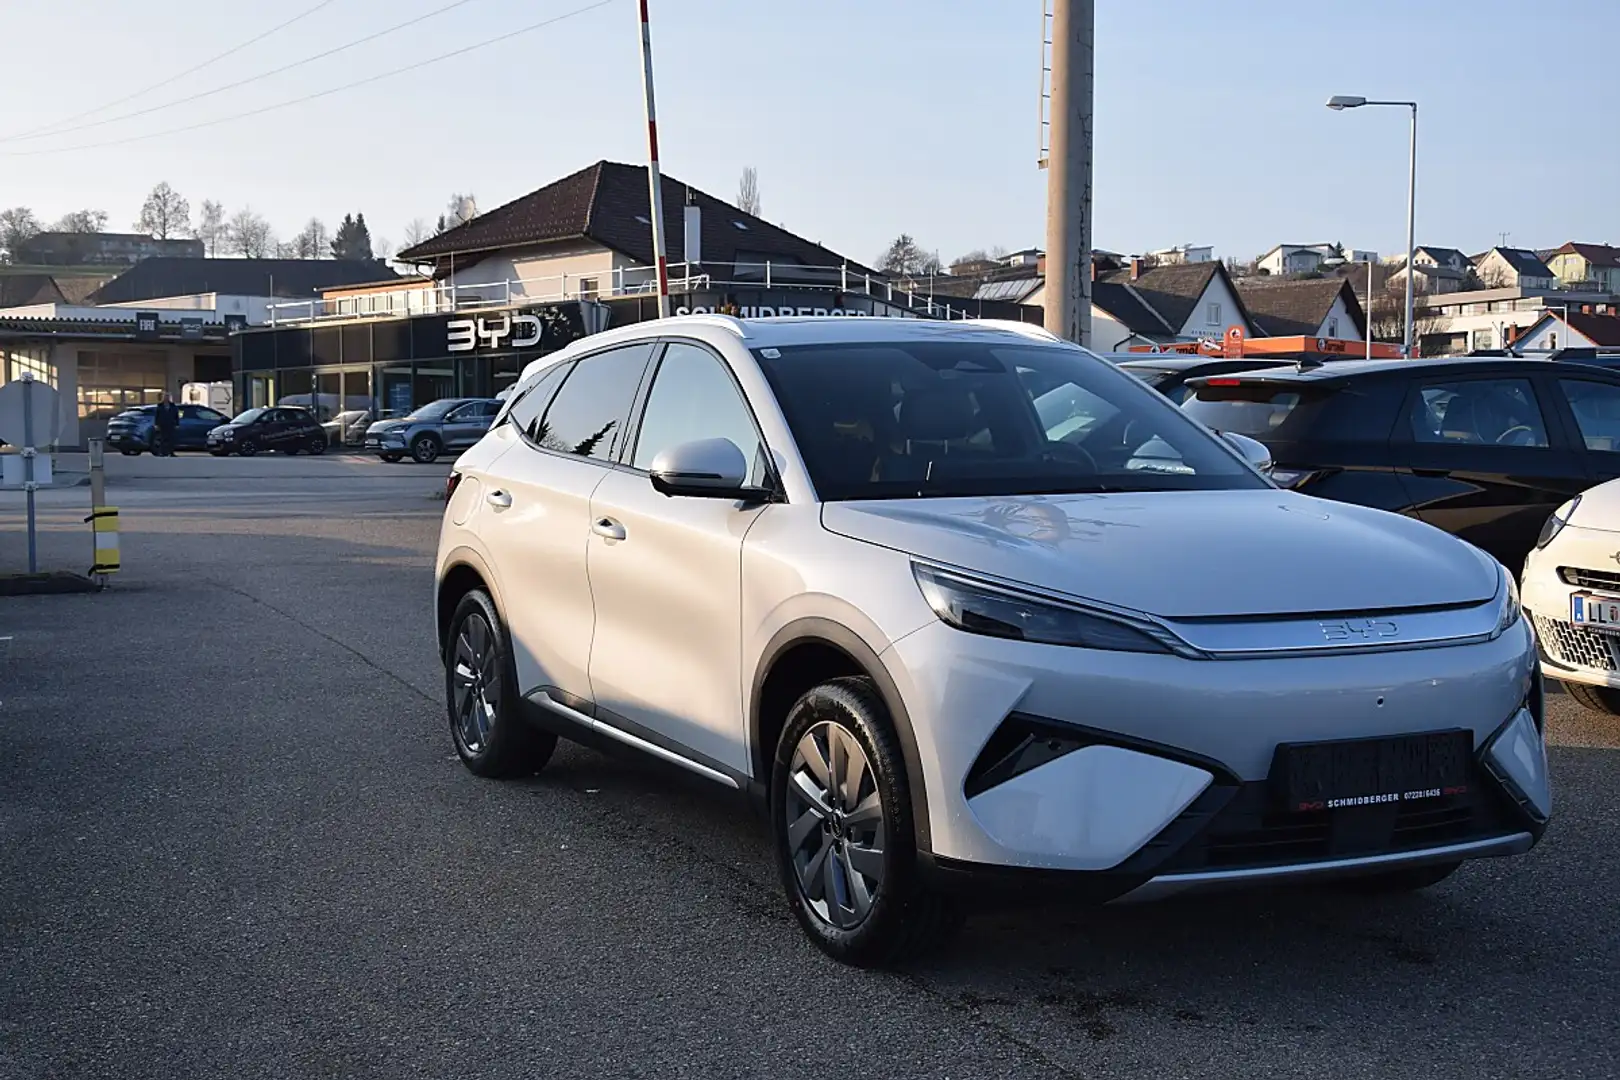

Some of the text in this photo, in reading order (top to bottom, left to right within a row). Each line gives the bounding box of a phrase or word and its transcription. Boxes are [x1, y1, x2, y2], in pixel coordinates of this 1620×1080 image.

[447, 314, 542, 350] BYD
[1319, 619, 1398, 640] BYD
[1328, 793, 1399, 808] SCHMIDBERGER
